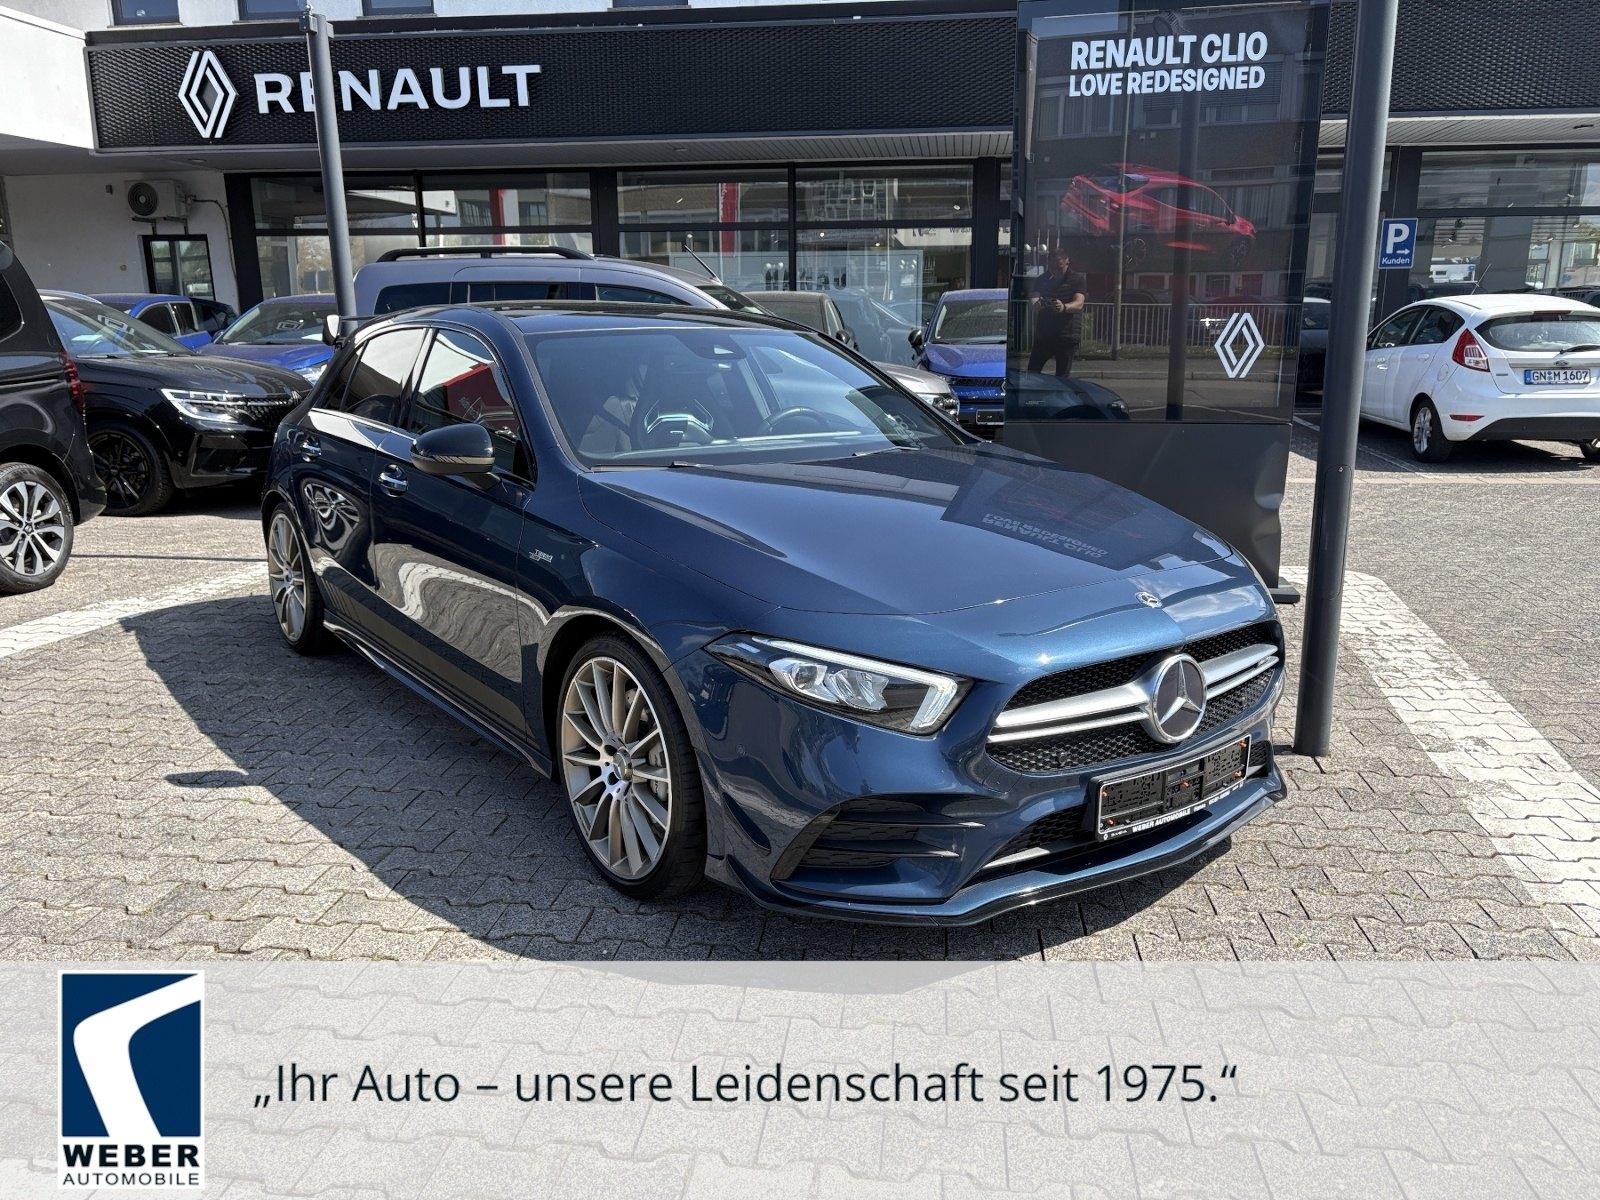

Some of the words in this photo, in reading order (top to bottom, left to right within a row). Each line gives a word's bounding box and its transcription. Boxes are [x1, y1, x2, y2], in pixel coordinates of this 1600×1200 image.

[1070, 34, 1197, 71] RENAULT
[1200, 31, 1268, 63] CLIO
[1069, 71, 1126, 97] LOVE
[1127, 65, 1266, 95] REDESIGNED
[1385, 223, 1410, 255] P
[1381, 256, 1410, 265] Kunden
[1532, 370, 1546, 381] GN
[1553, 370, 1561, 381] M
[1563, 370, 1589, 381] 1607
[1132, 822, 1154, 833] WEBER
[1155, 808, 1191, 826] AUTOMOBILE
